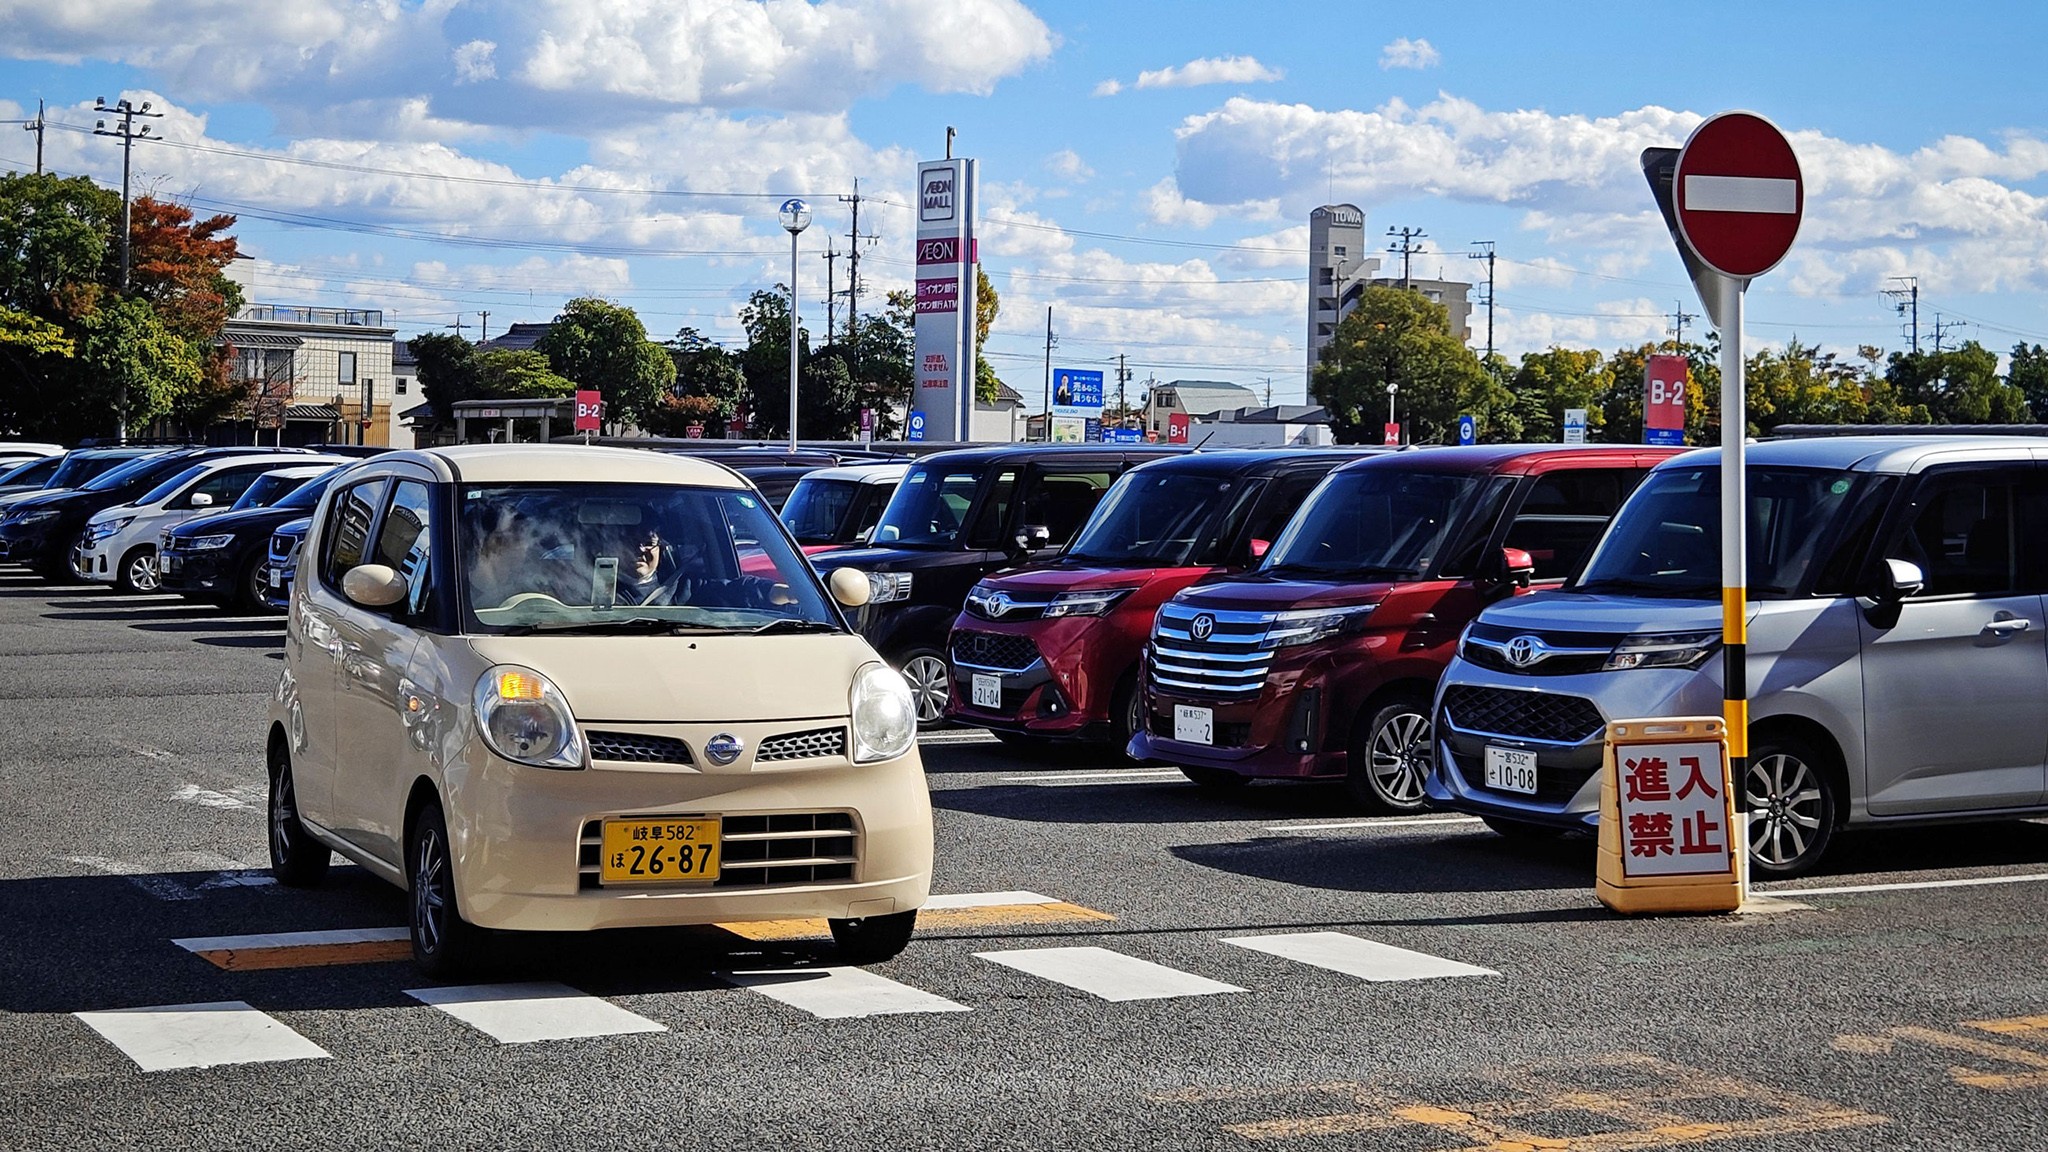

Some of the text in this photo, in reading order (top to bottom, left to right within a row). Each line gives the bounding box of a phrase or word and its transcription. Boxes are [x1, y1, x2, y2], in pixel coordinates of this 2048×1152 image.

[924, 195, 951, 210] MALL
[1334, 210, 1361, 223] TOWA
[926, 283, 957, 294] イオン銀行
[1651, 379, 1684, 405] B-2
[578, 403, 599, 417] B-2
[1170, 424, 1186, 438] B-1
[1499, 764, 1535, 790] 10-08
[1624, 757, 1718, 803] 進入
[632, 825, 695, 841] 岐阜582
[1628, 810, 1723, 858] 禁止
[611, 844, 713, 875] ほ 26-87
